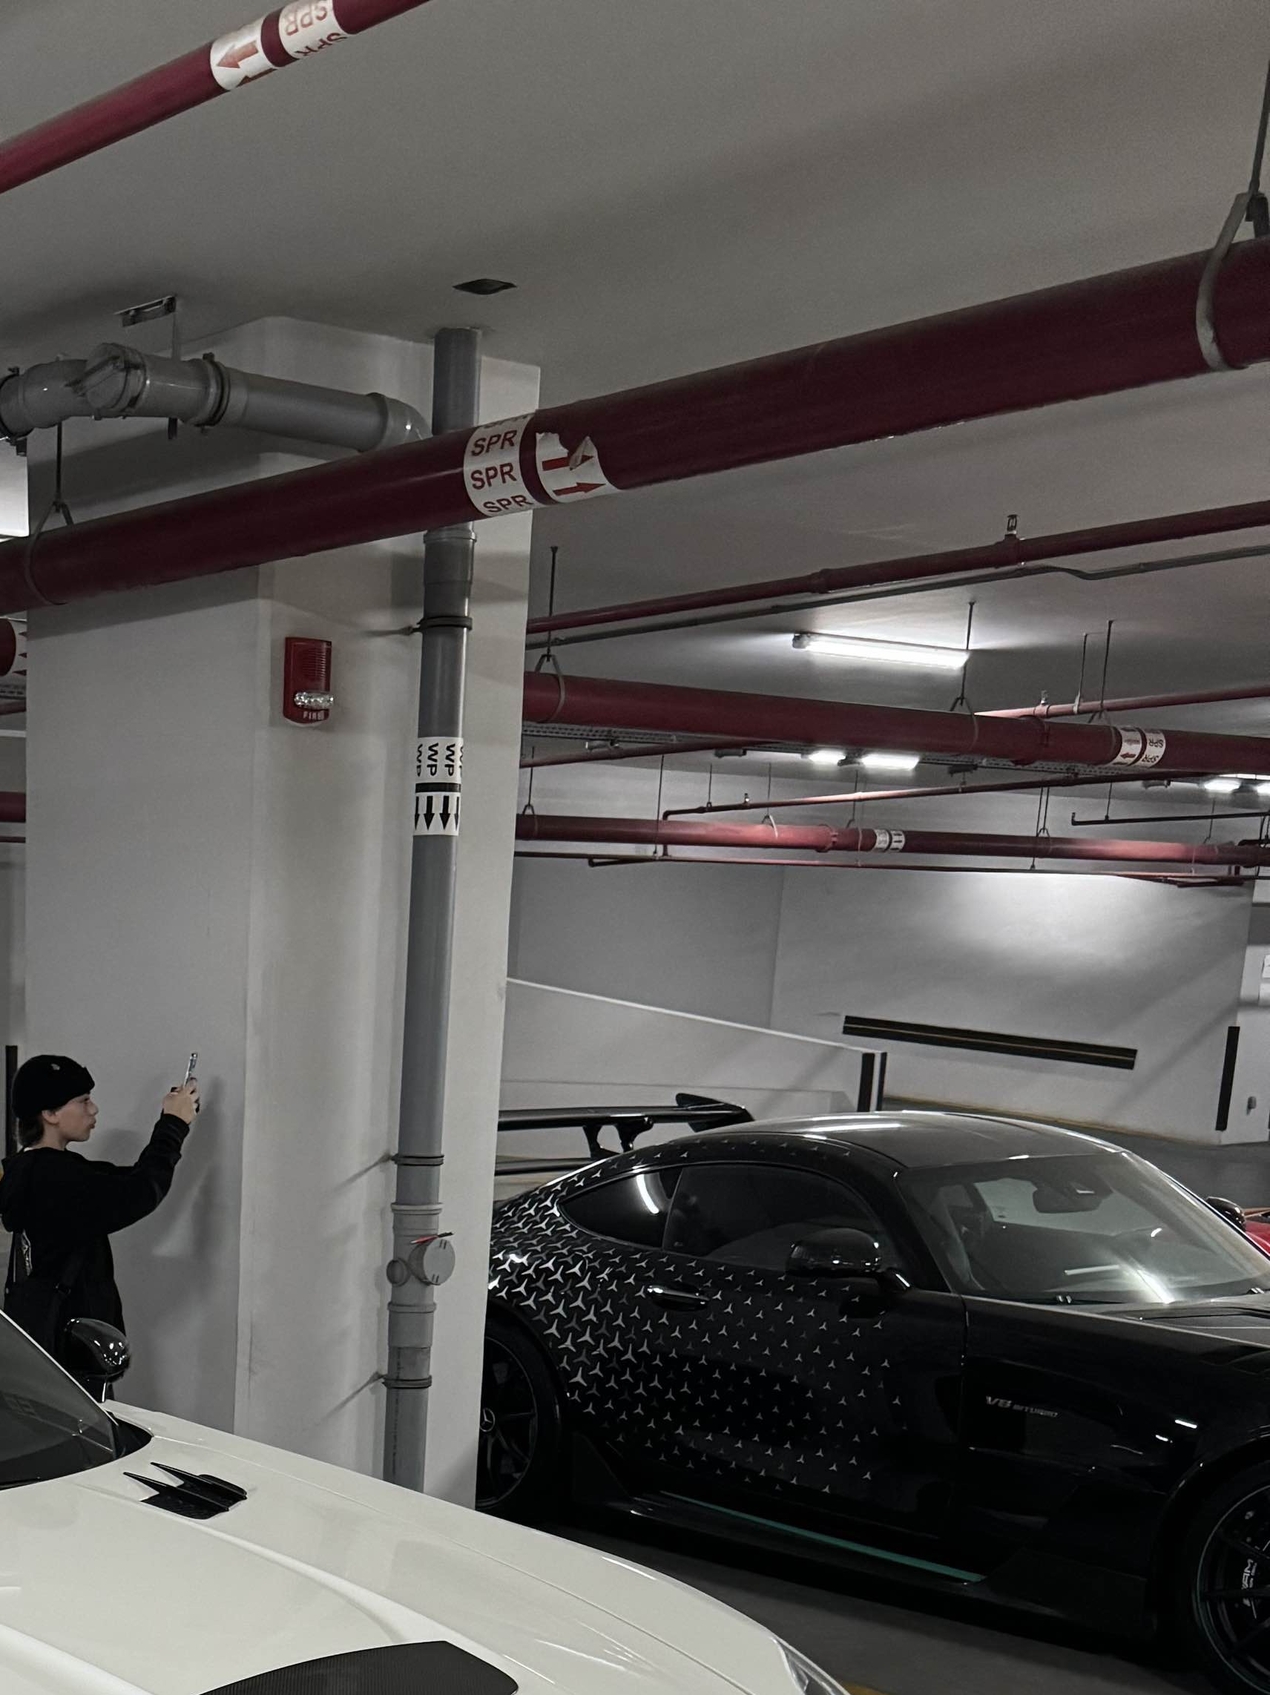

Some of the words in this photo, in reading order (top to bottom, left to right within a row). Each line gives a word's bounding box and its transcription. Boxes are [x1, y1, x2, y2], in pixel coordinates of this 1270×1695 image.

[471, 430, 518, 457] SPR
[470, 462, 518, 491] SPR
[483, 494, 533, 513] SPR
[426, 743, 439, 777] WP
[444, 743, 457, 777] WP
